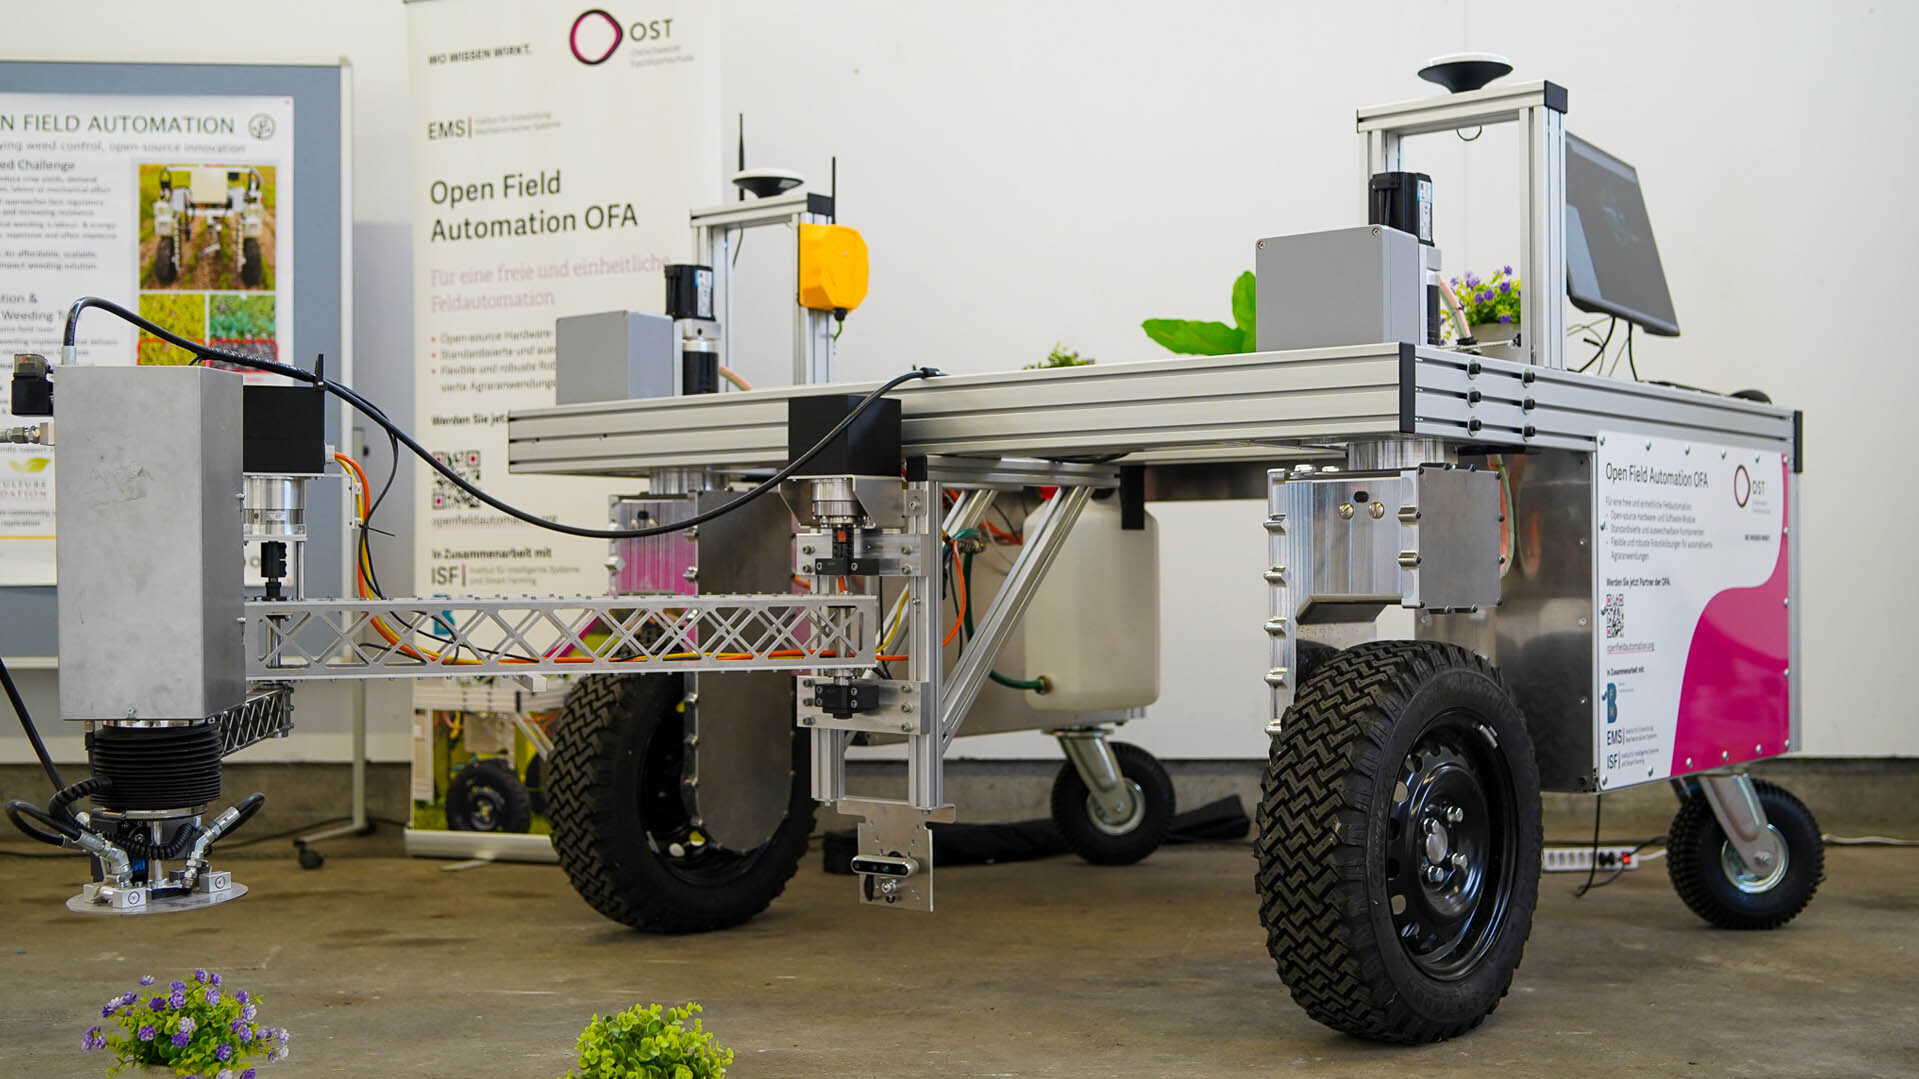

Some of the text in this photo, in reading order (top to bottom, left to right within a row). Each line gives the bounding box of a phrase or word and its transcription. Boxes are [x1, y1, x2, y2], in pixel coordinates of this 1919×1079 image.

[629, 18, 674, 42] OST
[449, 48, 490, 63] WISSEN
[23, 114, 80, 133] FIELD
[88, 114, 234, 134] AUTOMATION
[428, 118, 465, 141] EMS
[17, 159, 76, 172] Challenge
[430, 169, 562, 209] Open Field
[431, 203, 638, 242] Automation OFA
[431, 268, 458, 288] Für
[459, 269, 493, 286] eine
[498, 264, 534, 283] freie
[537, 260, 570, 281] und
[431, 290, 556, 314] Feldautomation
[1606, 462, 1709, 488] Open Field Automation OFA
[1752, 480, 1766, 496] OST
[536, 546, 552, 559] mit
[432, 566, 460, 586] ISF
[1607, 728, 1622, 746] EMS
[1607, 753, 1618, 770] ISF
